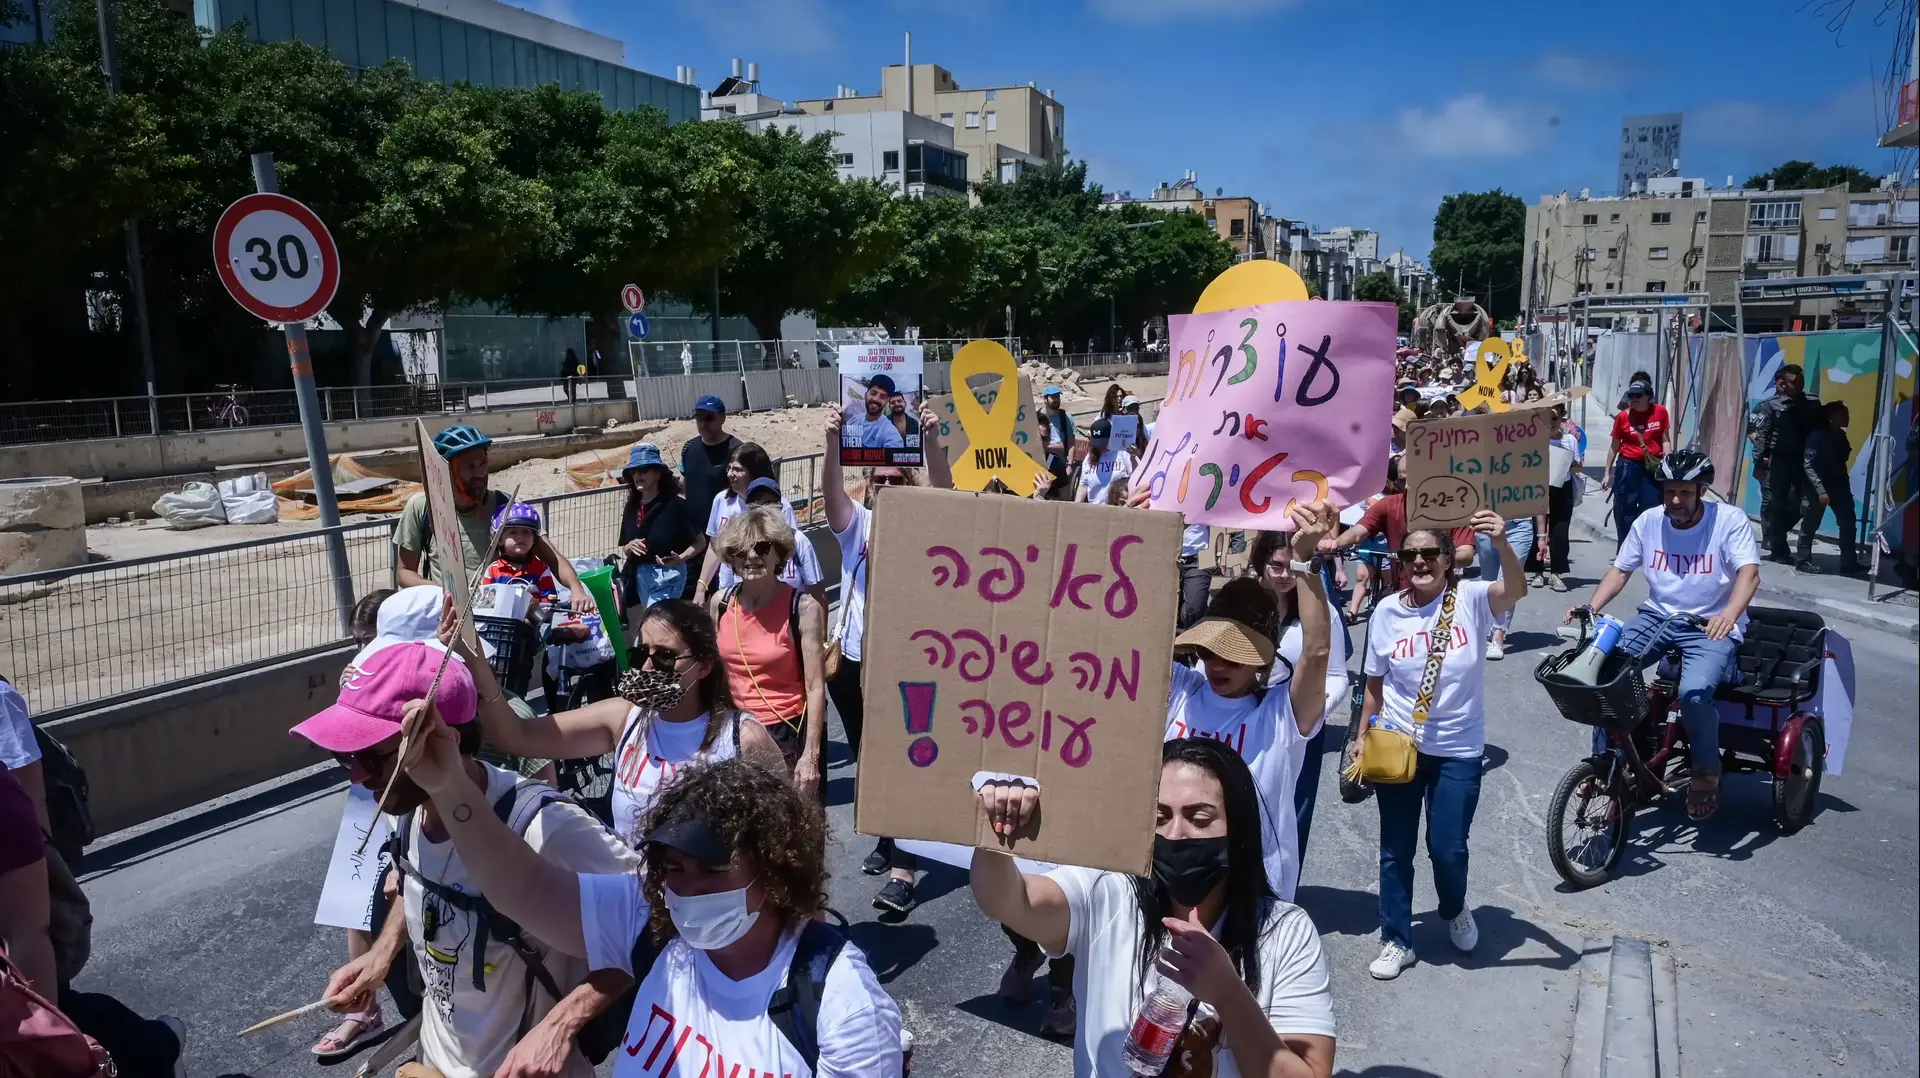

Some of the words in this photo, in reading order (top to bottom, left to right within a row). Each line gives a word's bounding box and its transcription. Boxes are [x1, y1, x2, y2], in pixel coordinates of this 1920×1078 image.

[245, 234, 309, 282] 30
[1163, 317, 1340, 407] עוצרות
[1478, 385, 1495, 399] NOW.
[842, 424, 864, 436] BRING
[1213, 410, 1269, 441] את
[1493, 412, 1540, 444] לפגוע
[842, 437, 863, 448] THEM
[975, 447, 1012, 470] NOW.
[1449, 455, 1482, 475] בא
[1490, 452, 1512, 475] לא
[1521, 450, 1543, 468] זה
[926, 544, 1040, 603] יפה
[1049, 535, 1145, 618] לא
[1649, 549, 1713, 574] עוצרות
[910, 629, 1054, 685] שיפה
[1069, 649, 1141, 702] מה
[958, 699, 1097, 768] עושה
